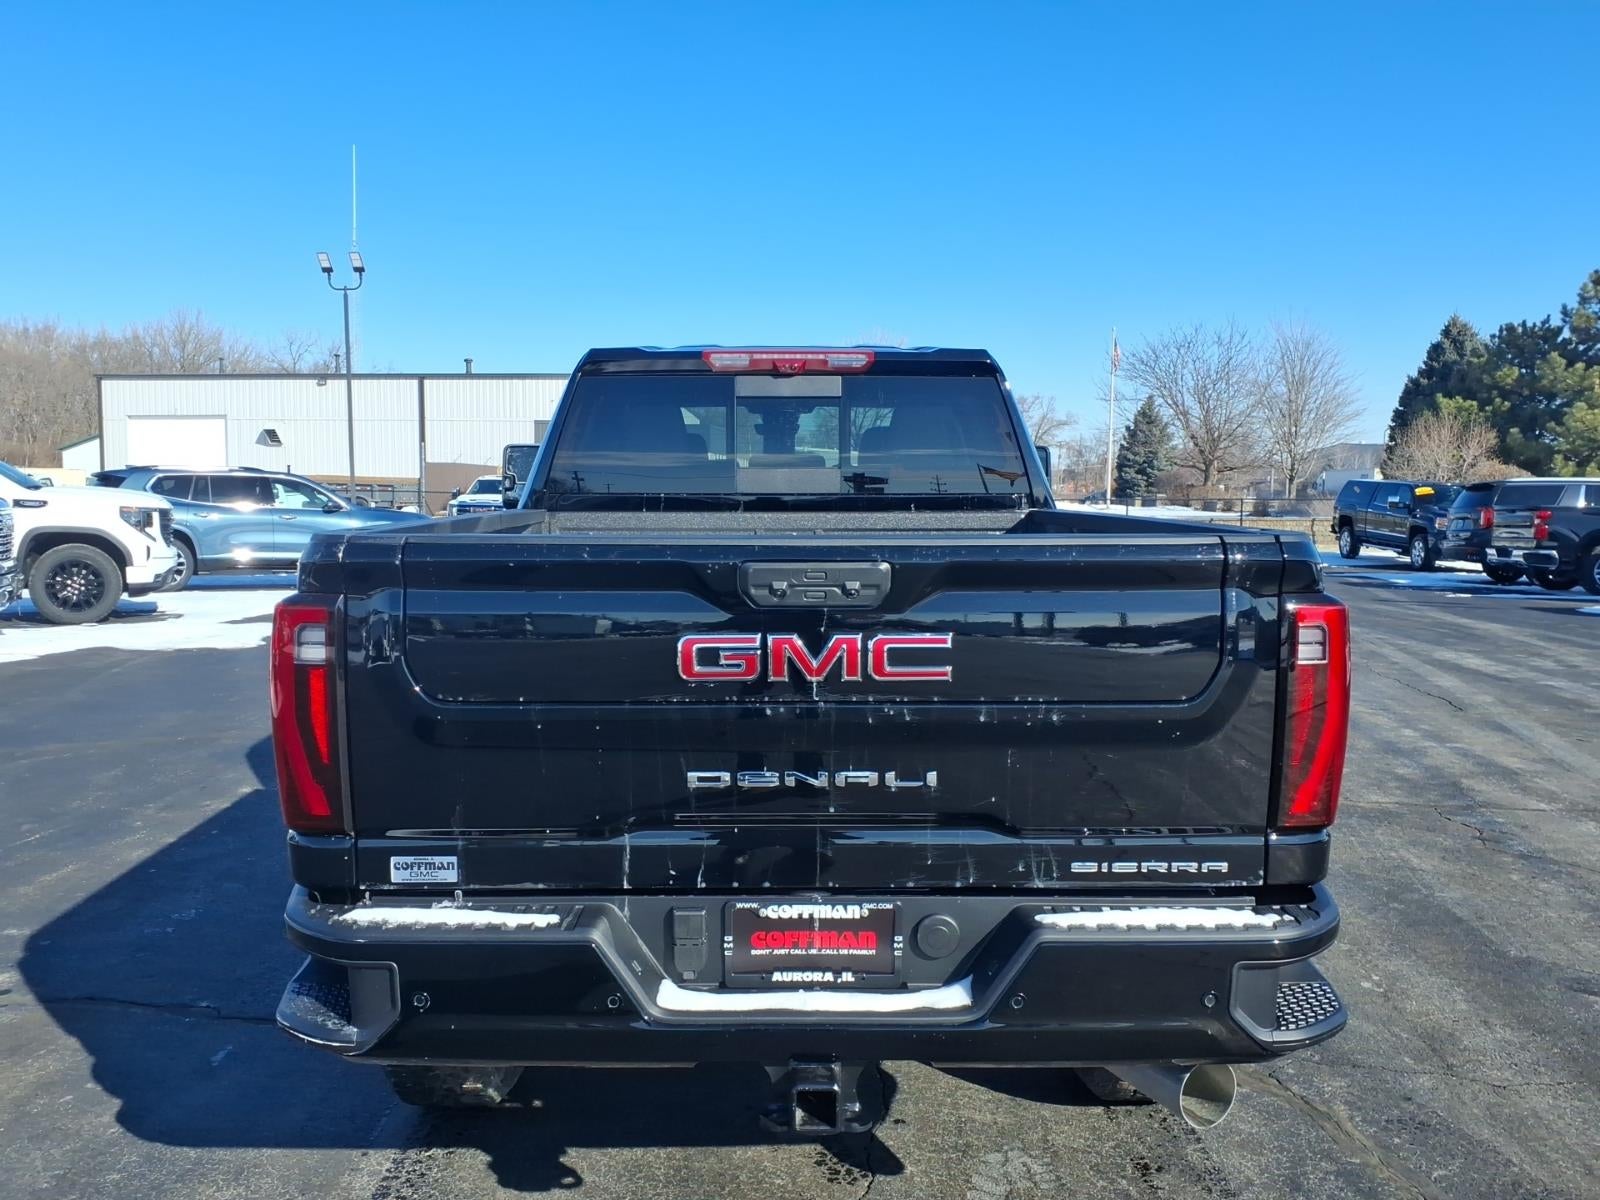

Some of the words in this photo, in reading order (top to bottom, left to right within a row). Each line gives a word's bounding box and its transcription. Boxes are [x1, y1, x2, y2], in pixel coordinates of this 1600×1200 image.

[677, 633, 953, 682] GMC
[687, 771, 937, 788] DENALI
[394, 861, 455, 871] COFFMAN
[1070, 862, 1229, 873] SIERRA
[766, 904, 861, 919] COFFMAN
[750, 931, 877, 949] COFFMAN
[771, 971, 835, 982] AURORA
